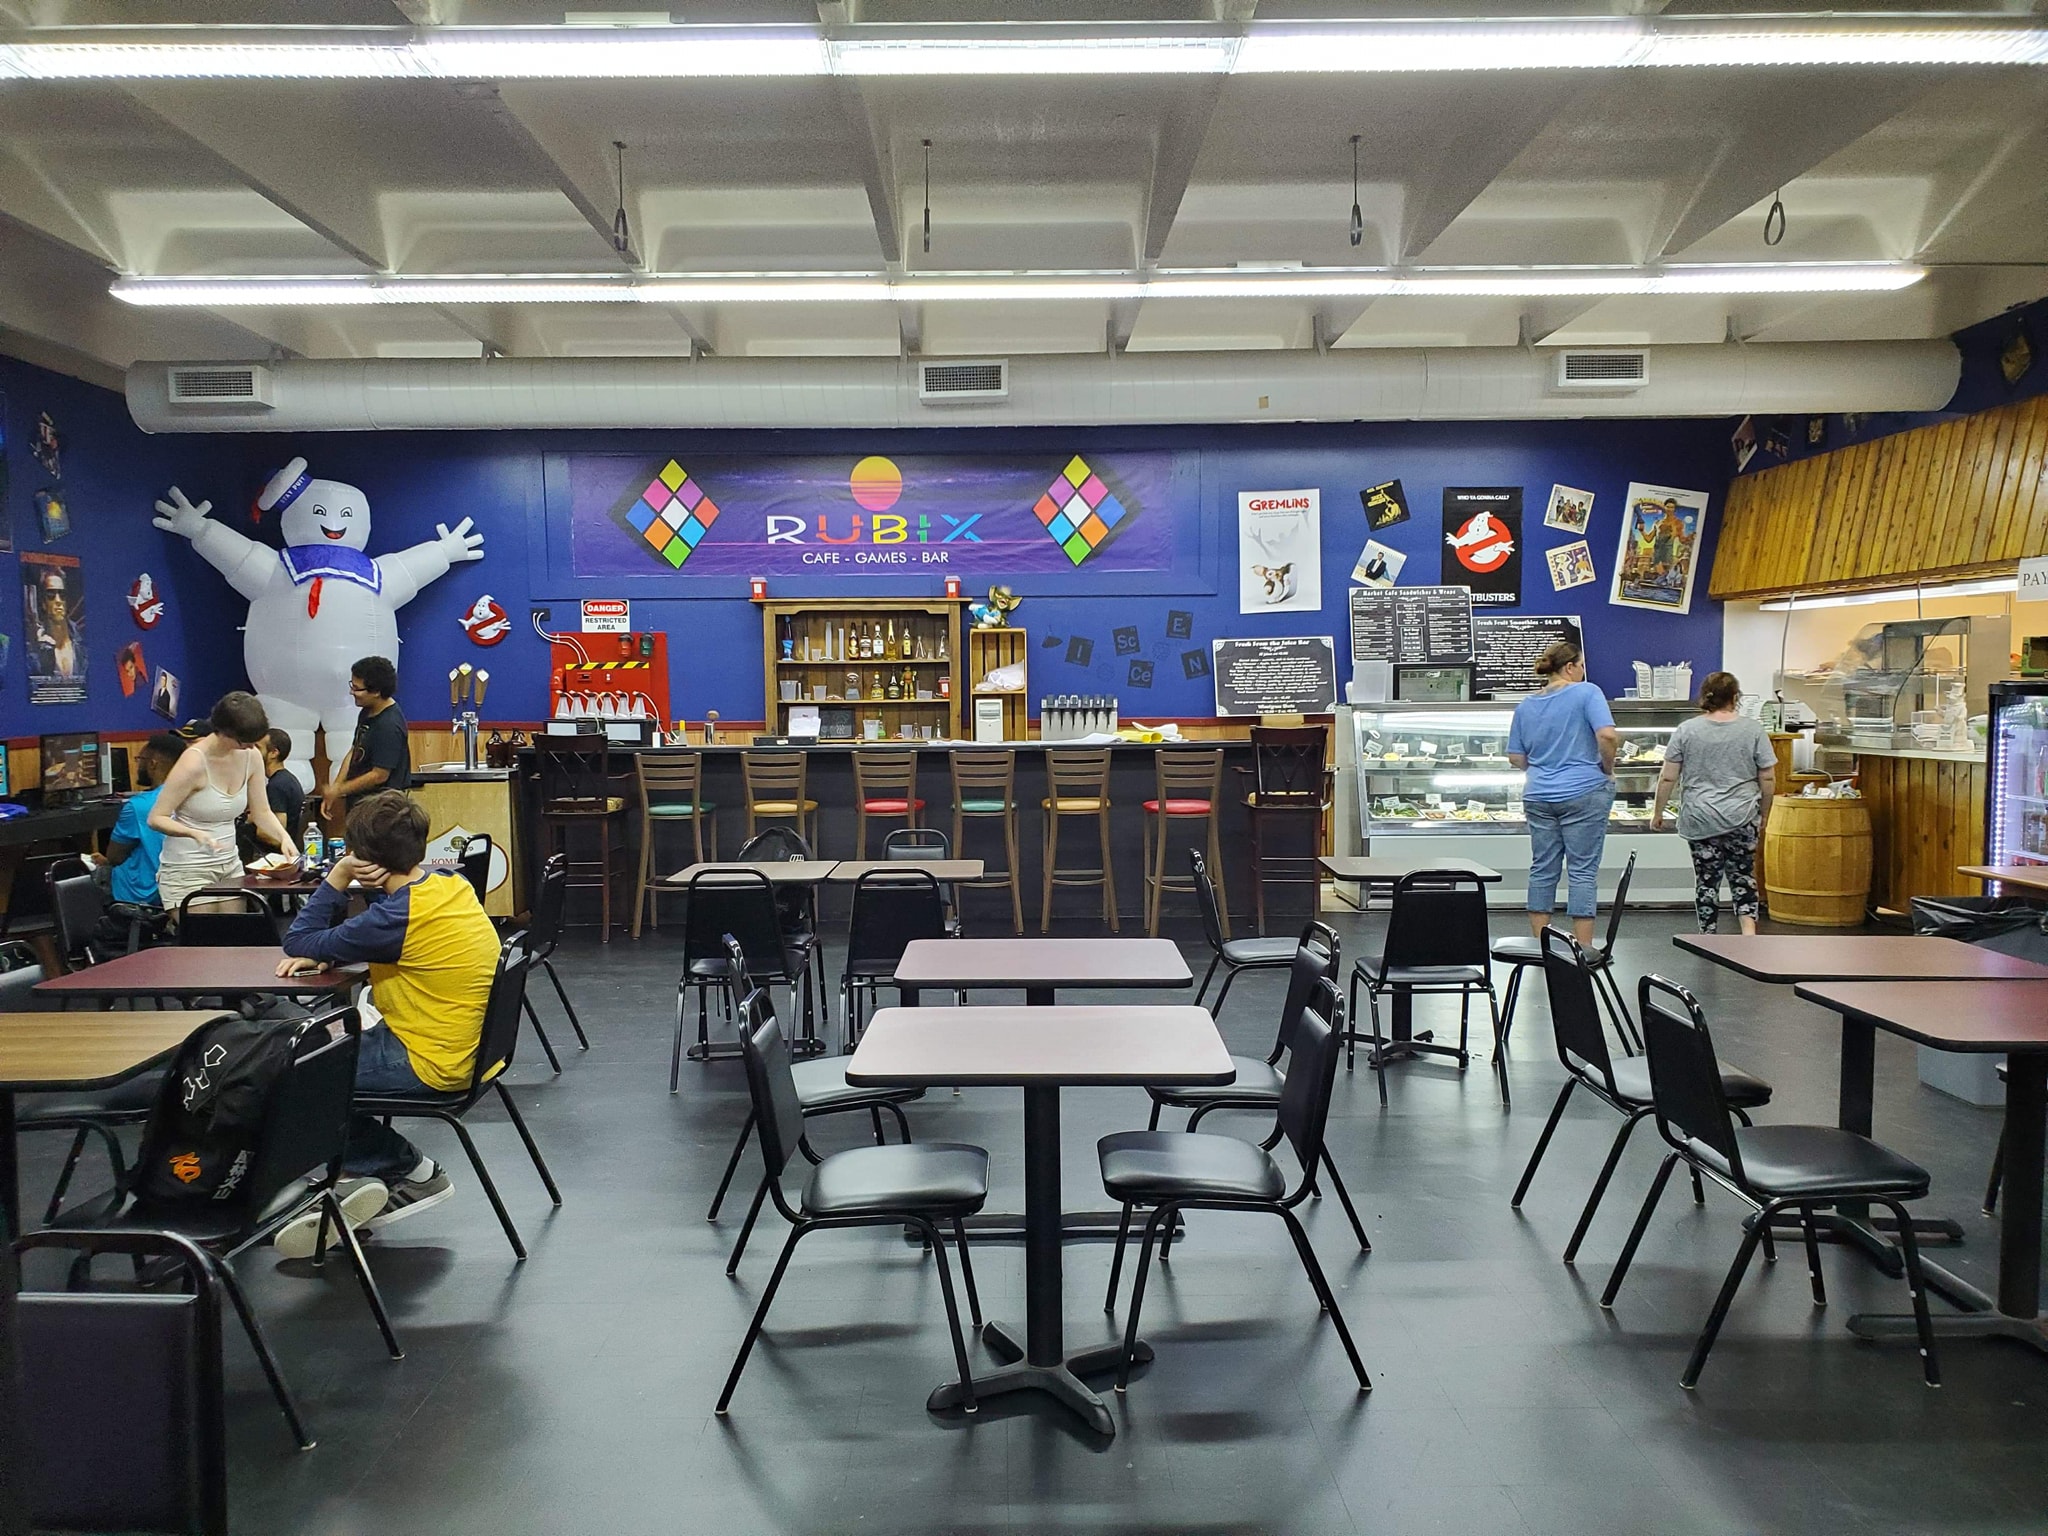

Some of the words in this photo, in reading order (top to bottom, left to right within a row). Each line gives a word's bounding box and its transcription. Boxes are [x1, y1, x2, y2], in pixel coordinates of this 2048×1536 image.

[766, 514, 984, 544] RUBIX
[802, 552, 840, 564] CAFE
[855, 551, 907, 564] GAMES
[922, 551, 949, 563] BAR
[1471, 593, 1516, 601] TBUSTERS
[1117, 634, 1137, 649] Sc
[1189, 657, 1201, 672] N
[1130, 667, 1151, 682] Ce
